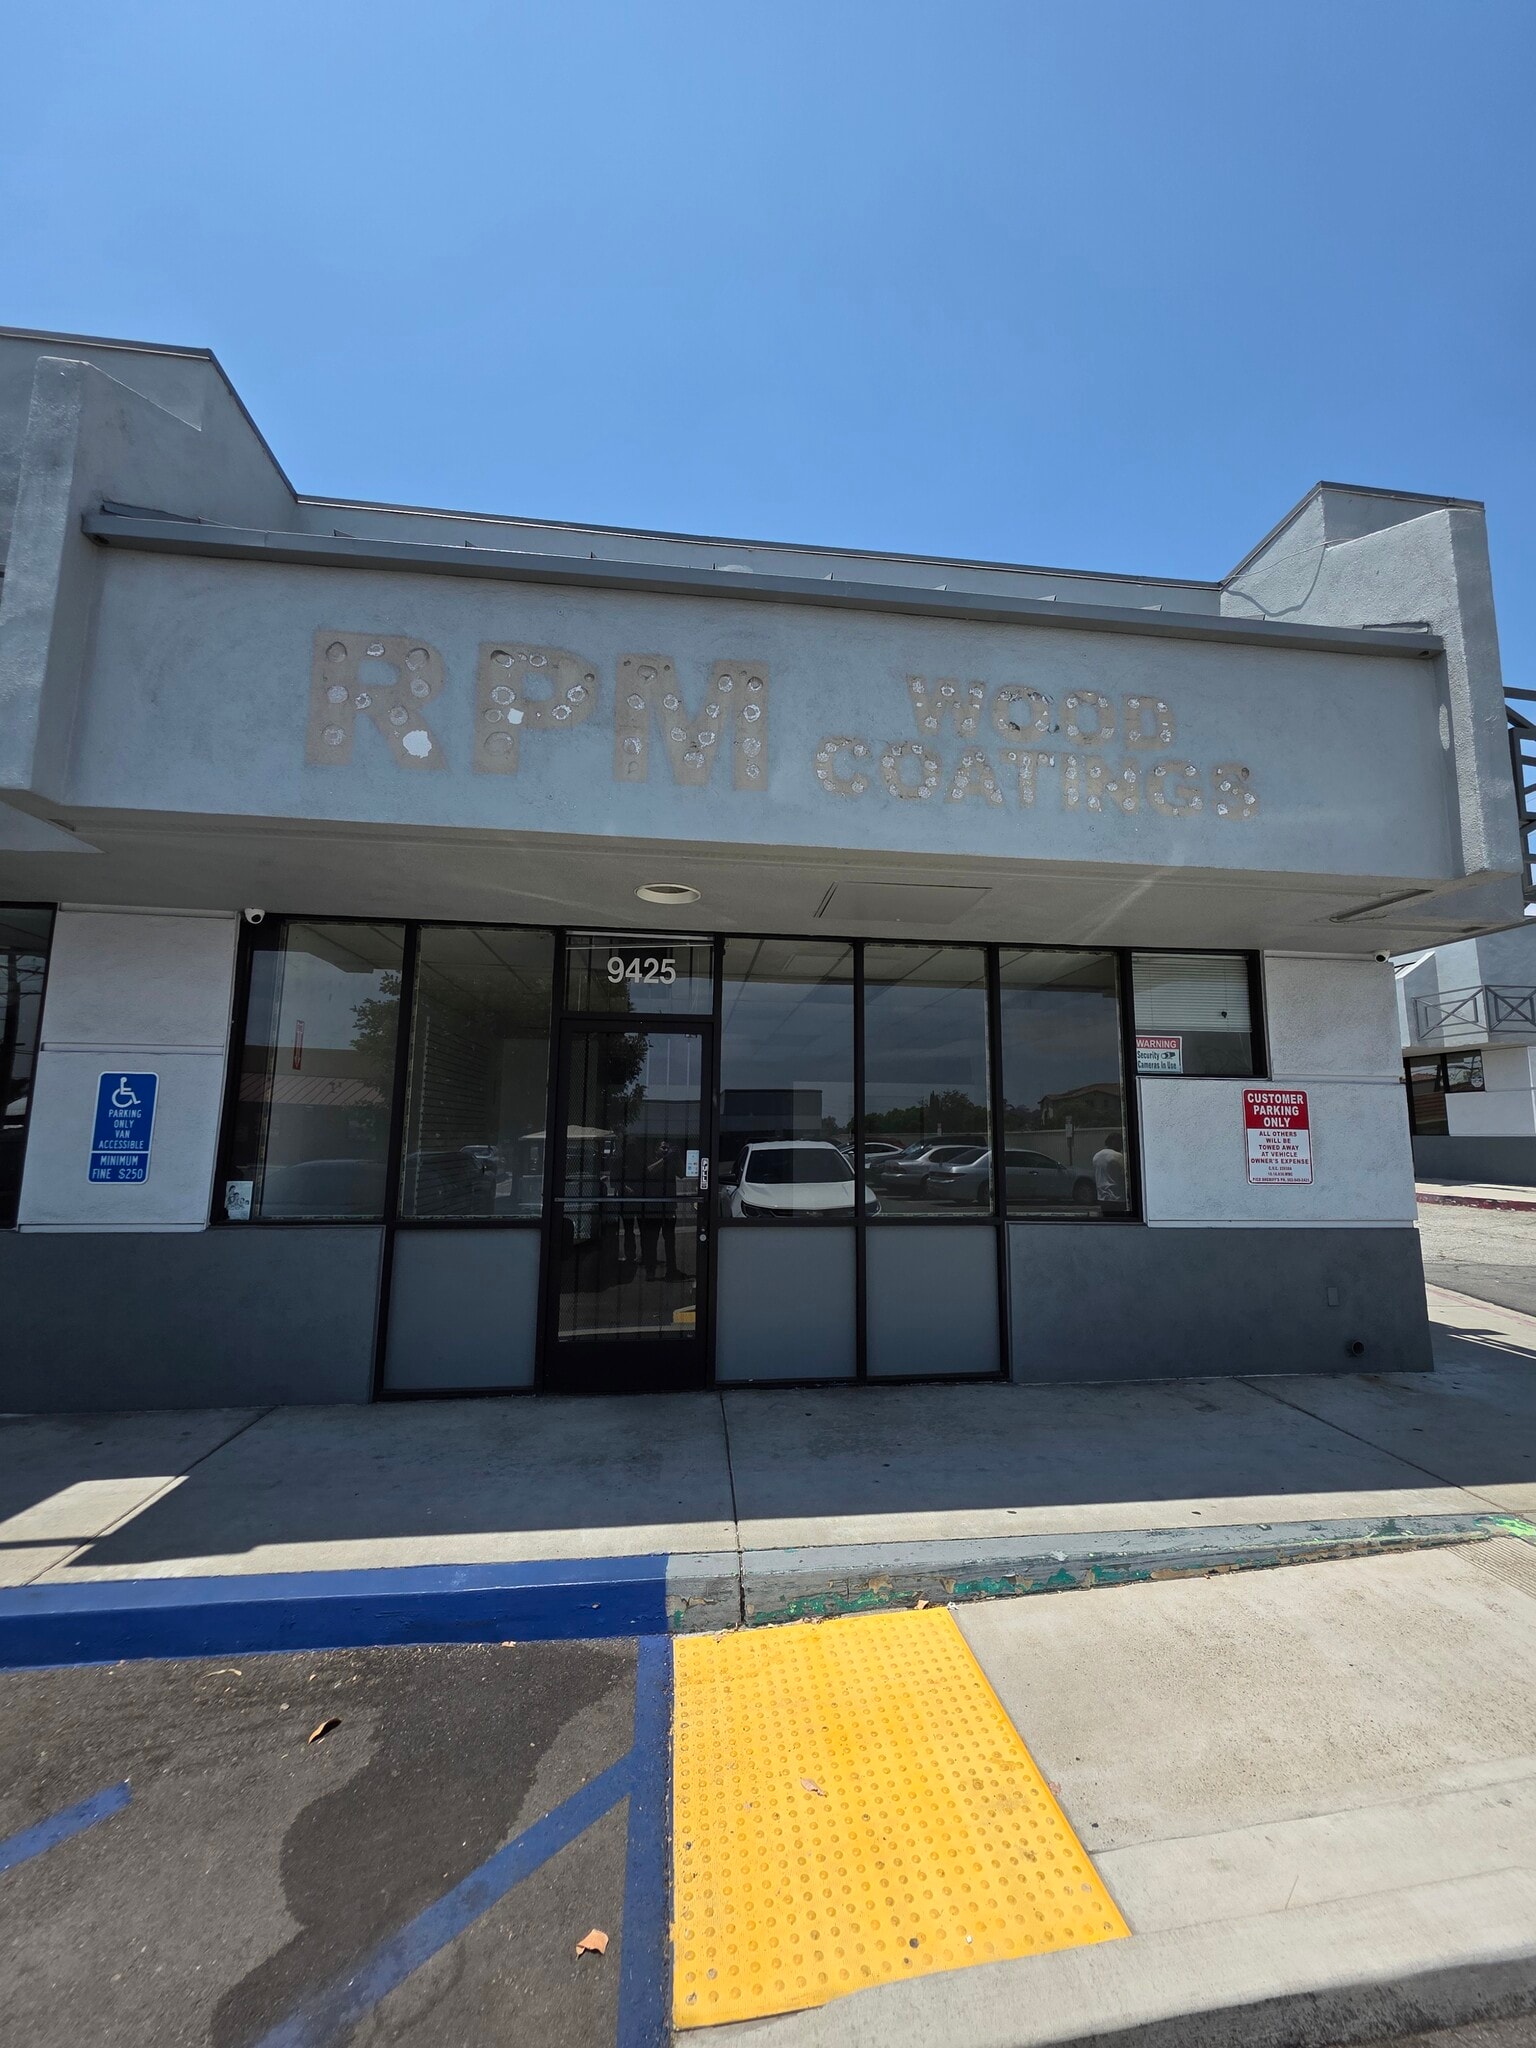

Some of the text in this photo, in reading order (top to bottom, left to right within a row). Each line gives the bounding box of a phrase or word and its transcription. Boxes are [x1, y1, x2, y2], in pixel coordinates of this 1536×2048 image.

[304, 629, 770, 791] RPM
[907, 674, 1176, 750] WOOD
[813, 735, 1260, 821] COATINGS
[607, 956, 676, 985] 9425
[1136, 1039, 1177, 1049] WARNING
[1137, 1050, 1160, 1060] Security
[1137, 1060, 1160, 1069] Cameras
[1247, 1093, 1304, 1104] CUSTOMER
[108, 1109, 142, 1118] PARKING
[1253, 1105, 1299, 1116] PARKING
[113, 1119, 134, 1128] ONLY
[1263, 1117, 1290, 1127] ONLY
[115, 1130, 130, 1138] VAN
[98, 1140, 144, 1149] ACCESSIBLE
[100, 1155, 139, 1166] MINIMUM
[91, 1168, 112, 1179] FINE
